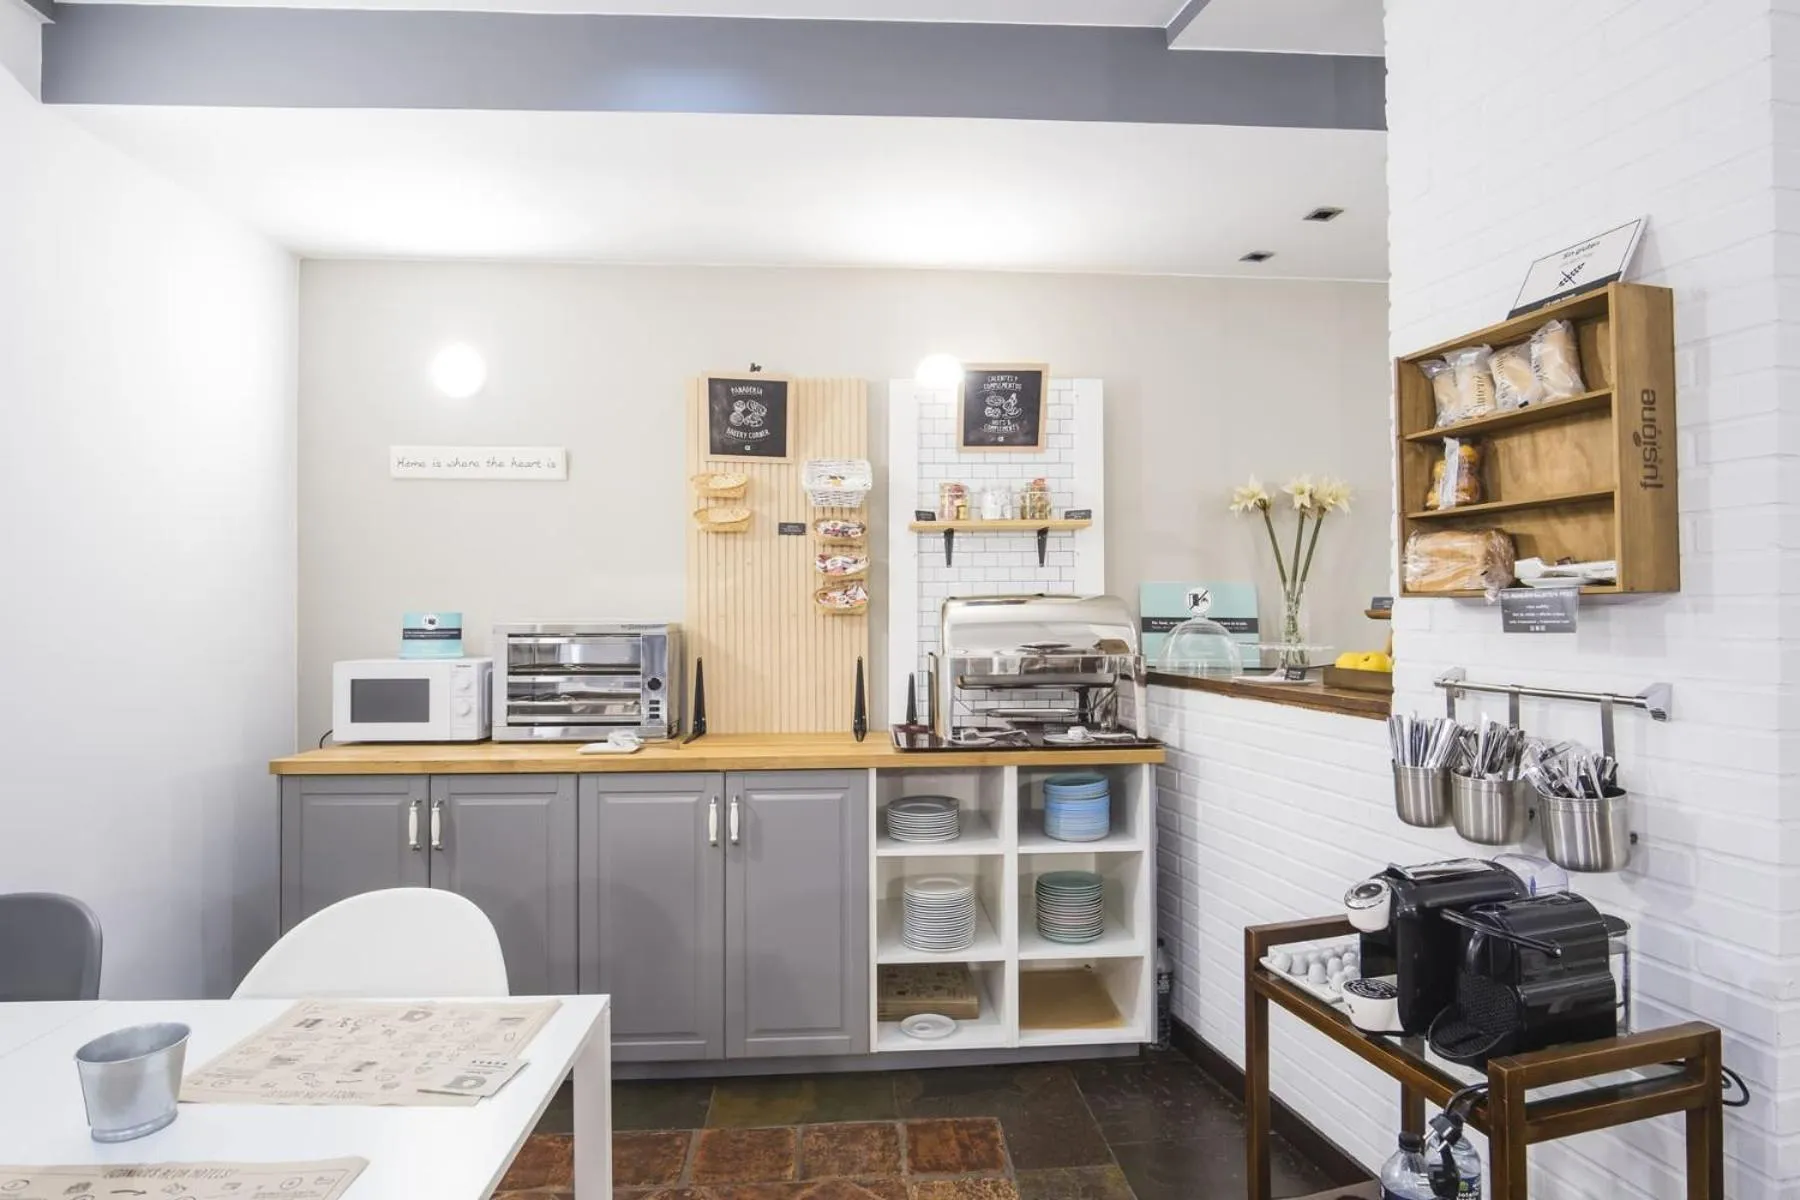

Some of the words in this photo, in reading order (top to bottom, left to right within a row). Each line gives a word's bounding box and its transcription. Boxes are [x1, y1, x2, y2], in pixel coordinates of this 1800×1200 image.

[726, 427, 747, 438] BAKERY
[1640, 389, 1664, 490] fusione
[432, 457, 441, 468] is
[447, 457, 480, 468] where
[486, 456, 505, 468] the
[511, 456, 542, 468] heart
[546, 457, 556, 468] is
